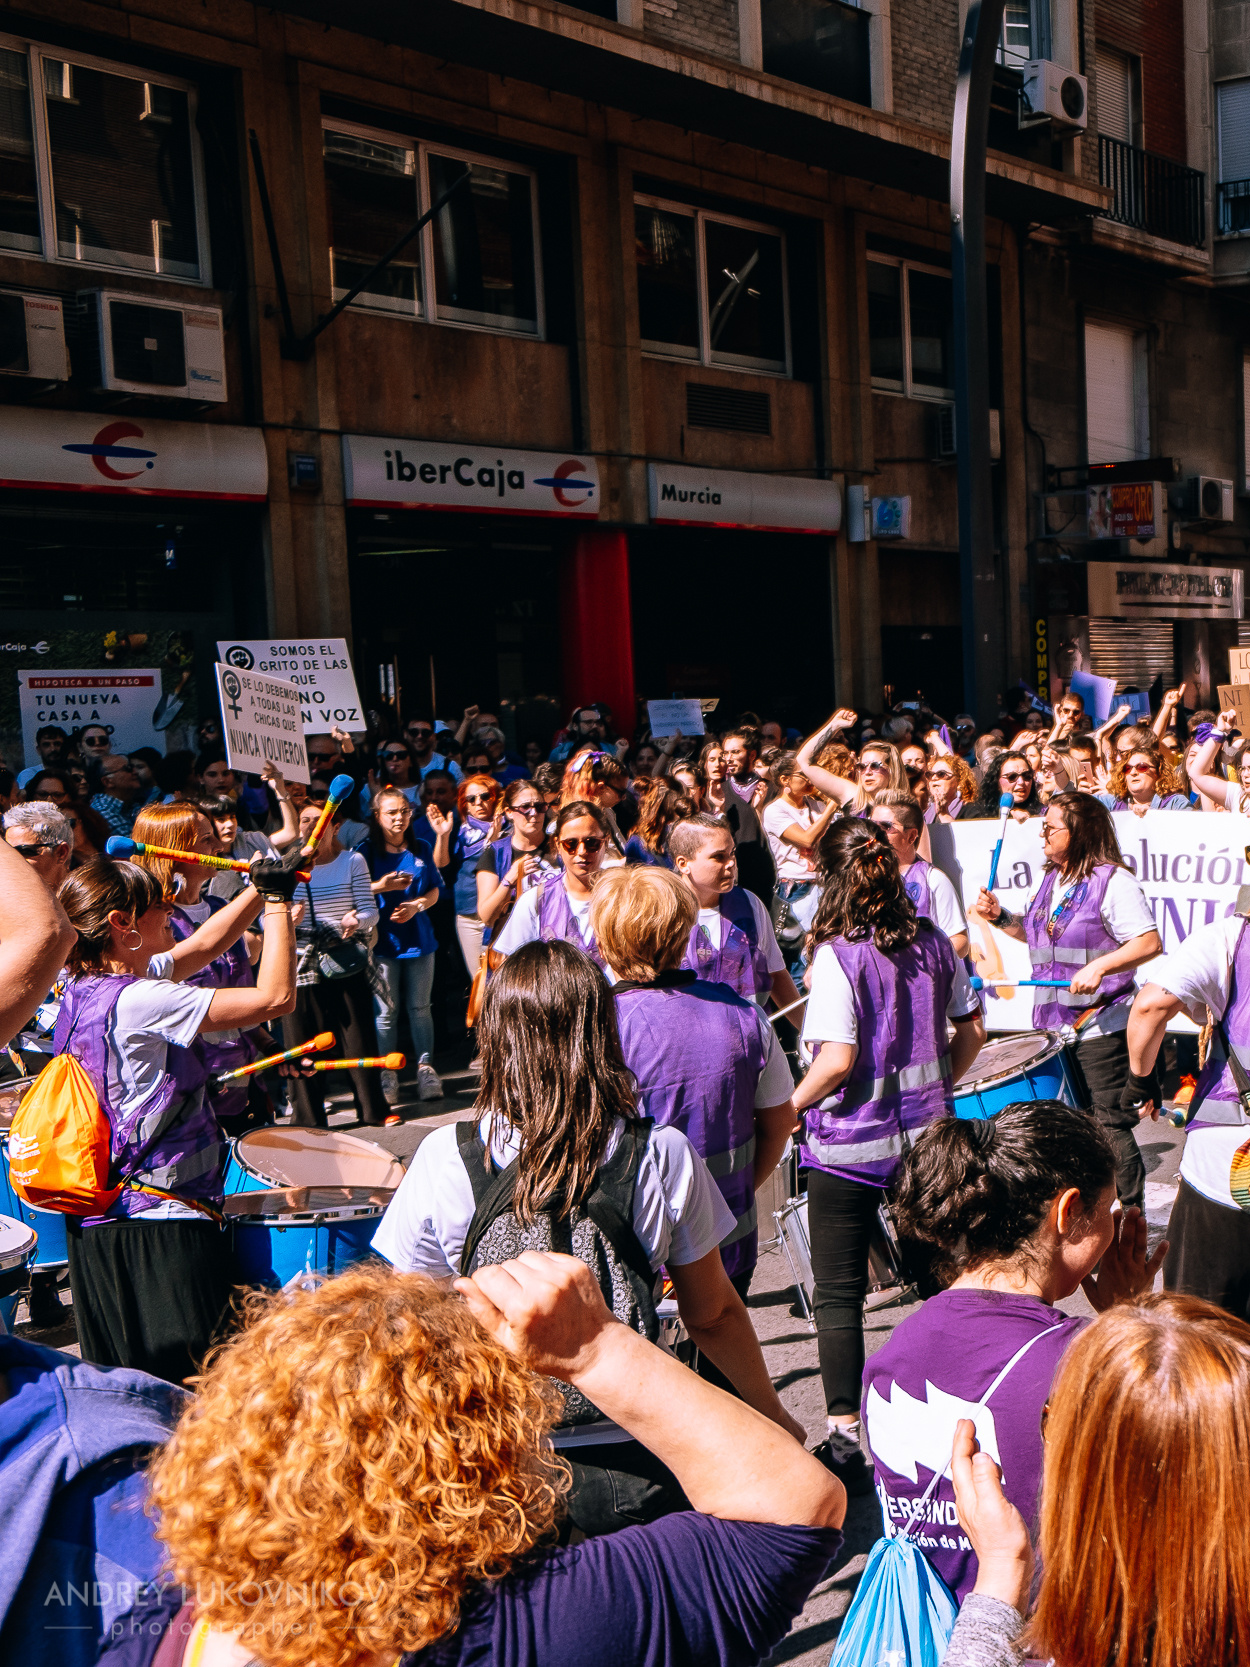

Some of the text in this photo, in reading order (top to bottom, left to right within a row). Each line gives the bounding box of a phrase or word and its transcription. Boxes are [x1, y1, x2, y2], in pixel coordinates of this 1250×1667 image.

[24, 300, 60, 312] TOSHIBA
[384, 450, 525, 497] iberCaja
[661, 484, 722, 505] Murcia
[1134, 485, 1153, 521] ORO
[0, 643, 27, 653] rCaja
[270, 645, 335, 656] SOMOS EL
[259, 659, 348, 671] GRITO DE LAS
[34, 678, 82, 687] HIPOTECA
[87, 678, 94, 686] A
[98, 678, 111, 686] UN
[291, 674, 317, 685] QUE
[241, 677, 298, 701] SE LO DEBEMOS
[35, 693, 121, 706] TU NUEVA
[250, 695, 296, 716] A TODAS LAS
[1223, 689, 1242, 706] NI
[37, 709, 100, 722] CASA A
[254, 712, 297, 732] CHICAS QUE
[320, 708, 359, 722] VOZ
[230, 728, 306, 767] NUNCA VOLVIERON
[989, 849, 1032, 890] La
[939, 1534, 957, 1550] de
